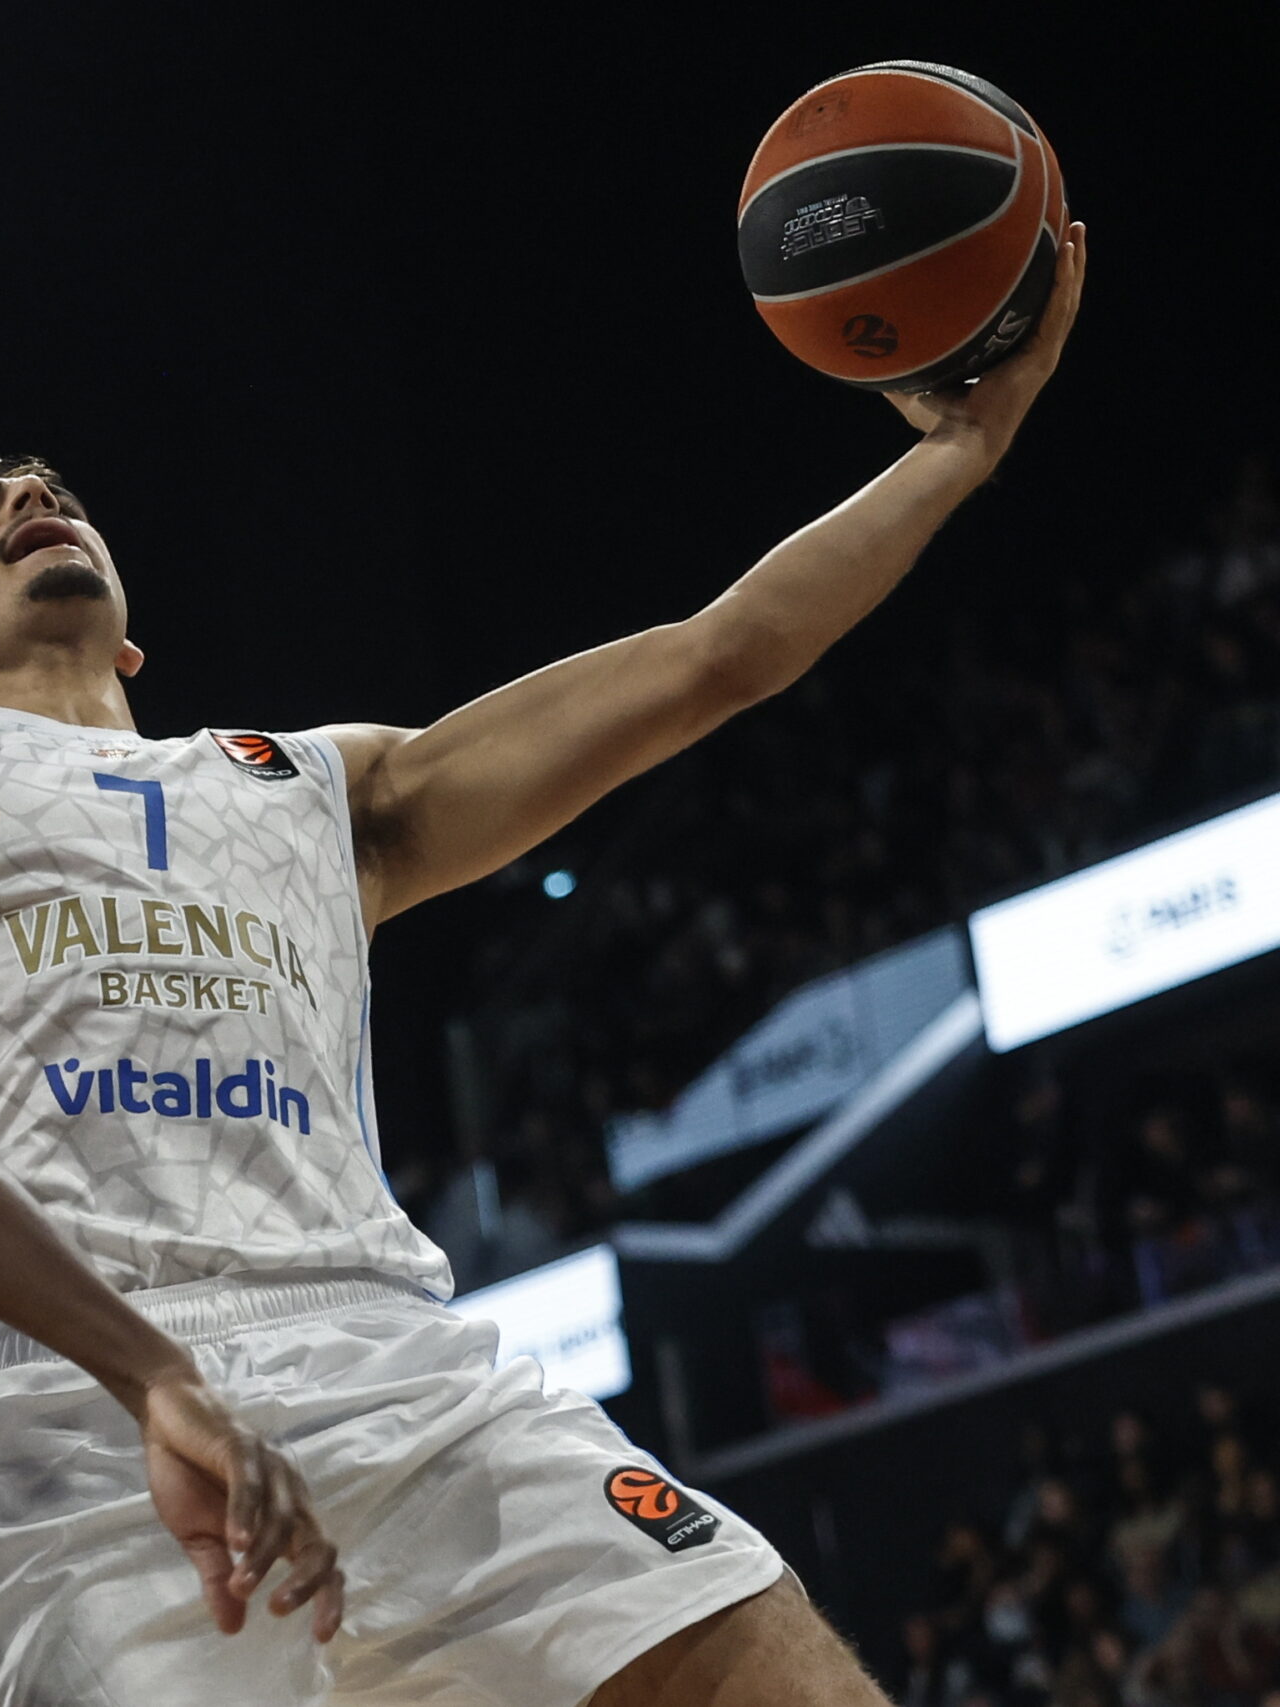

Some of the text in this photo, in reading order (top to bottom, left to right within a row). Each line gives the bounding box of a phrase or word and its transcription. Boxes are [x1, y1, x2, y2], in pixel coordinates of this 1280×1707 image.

[92, 772, 169, 871] 7
[2, 895, 319, 1012] VALENCIA
[99, 971, 273, 1015] BASKET
[667, 1514, 715, 1545] ETIHAD
